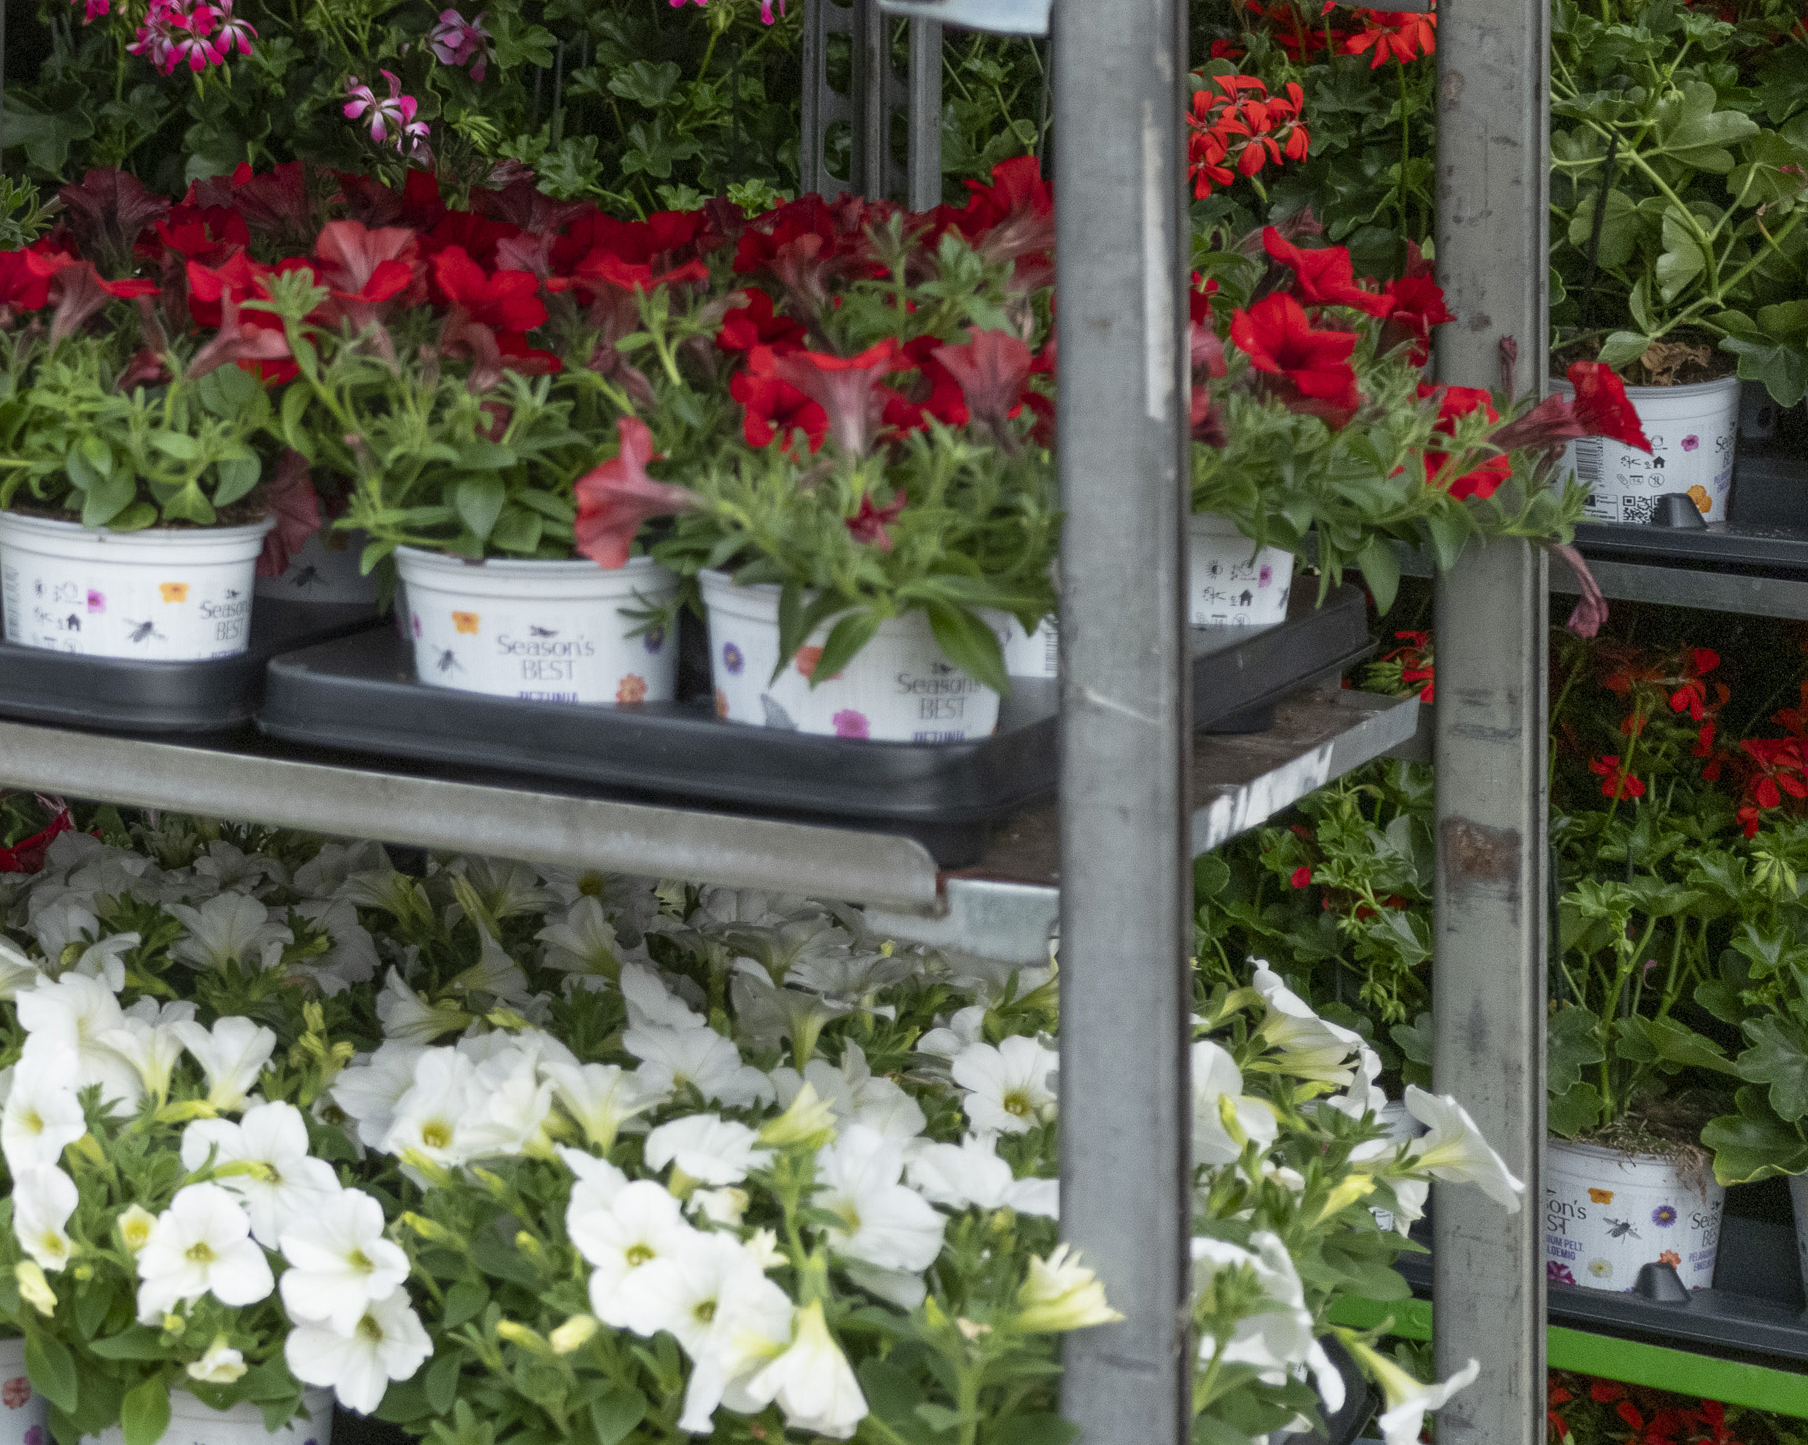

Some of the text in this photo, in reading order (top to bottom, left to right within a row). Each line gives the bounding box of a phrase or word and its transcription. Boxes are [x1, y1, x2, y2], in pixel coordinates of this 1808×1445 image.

[496, 634, 595, 657] Season's
[521, 660, 574, 680] BEST
[918, 696, 966, 721] BEST
